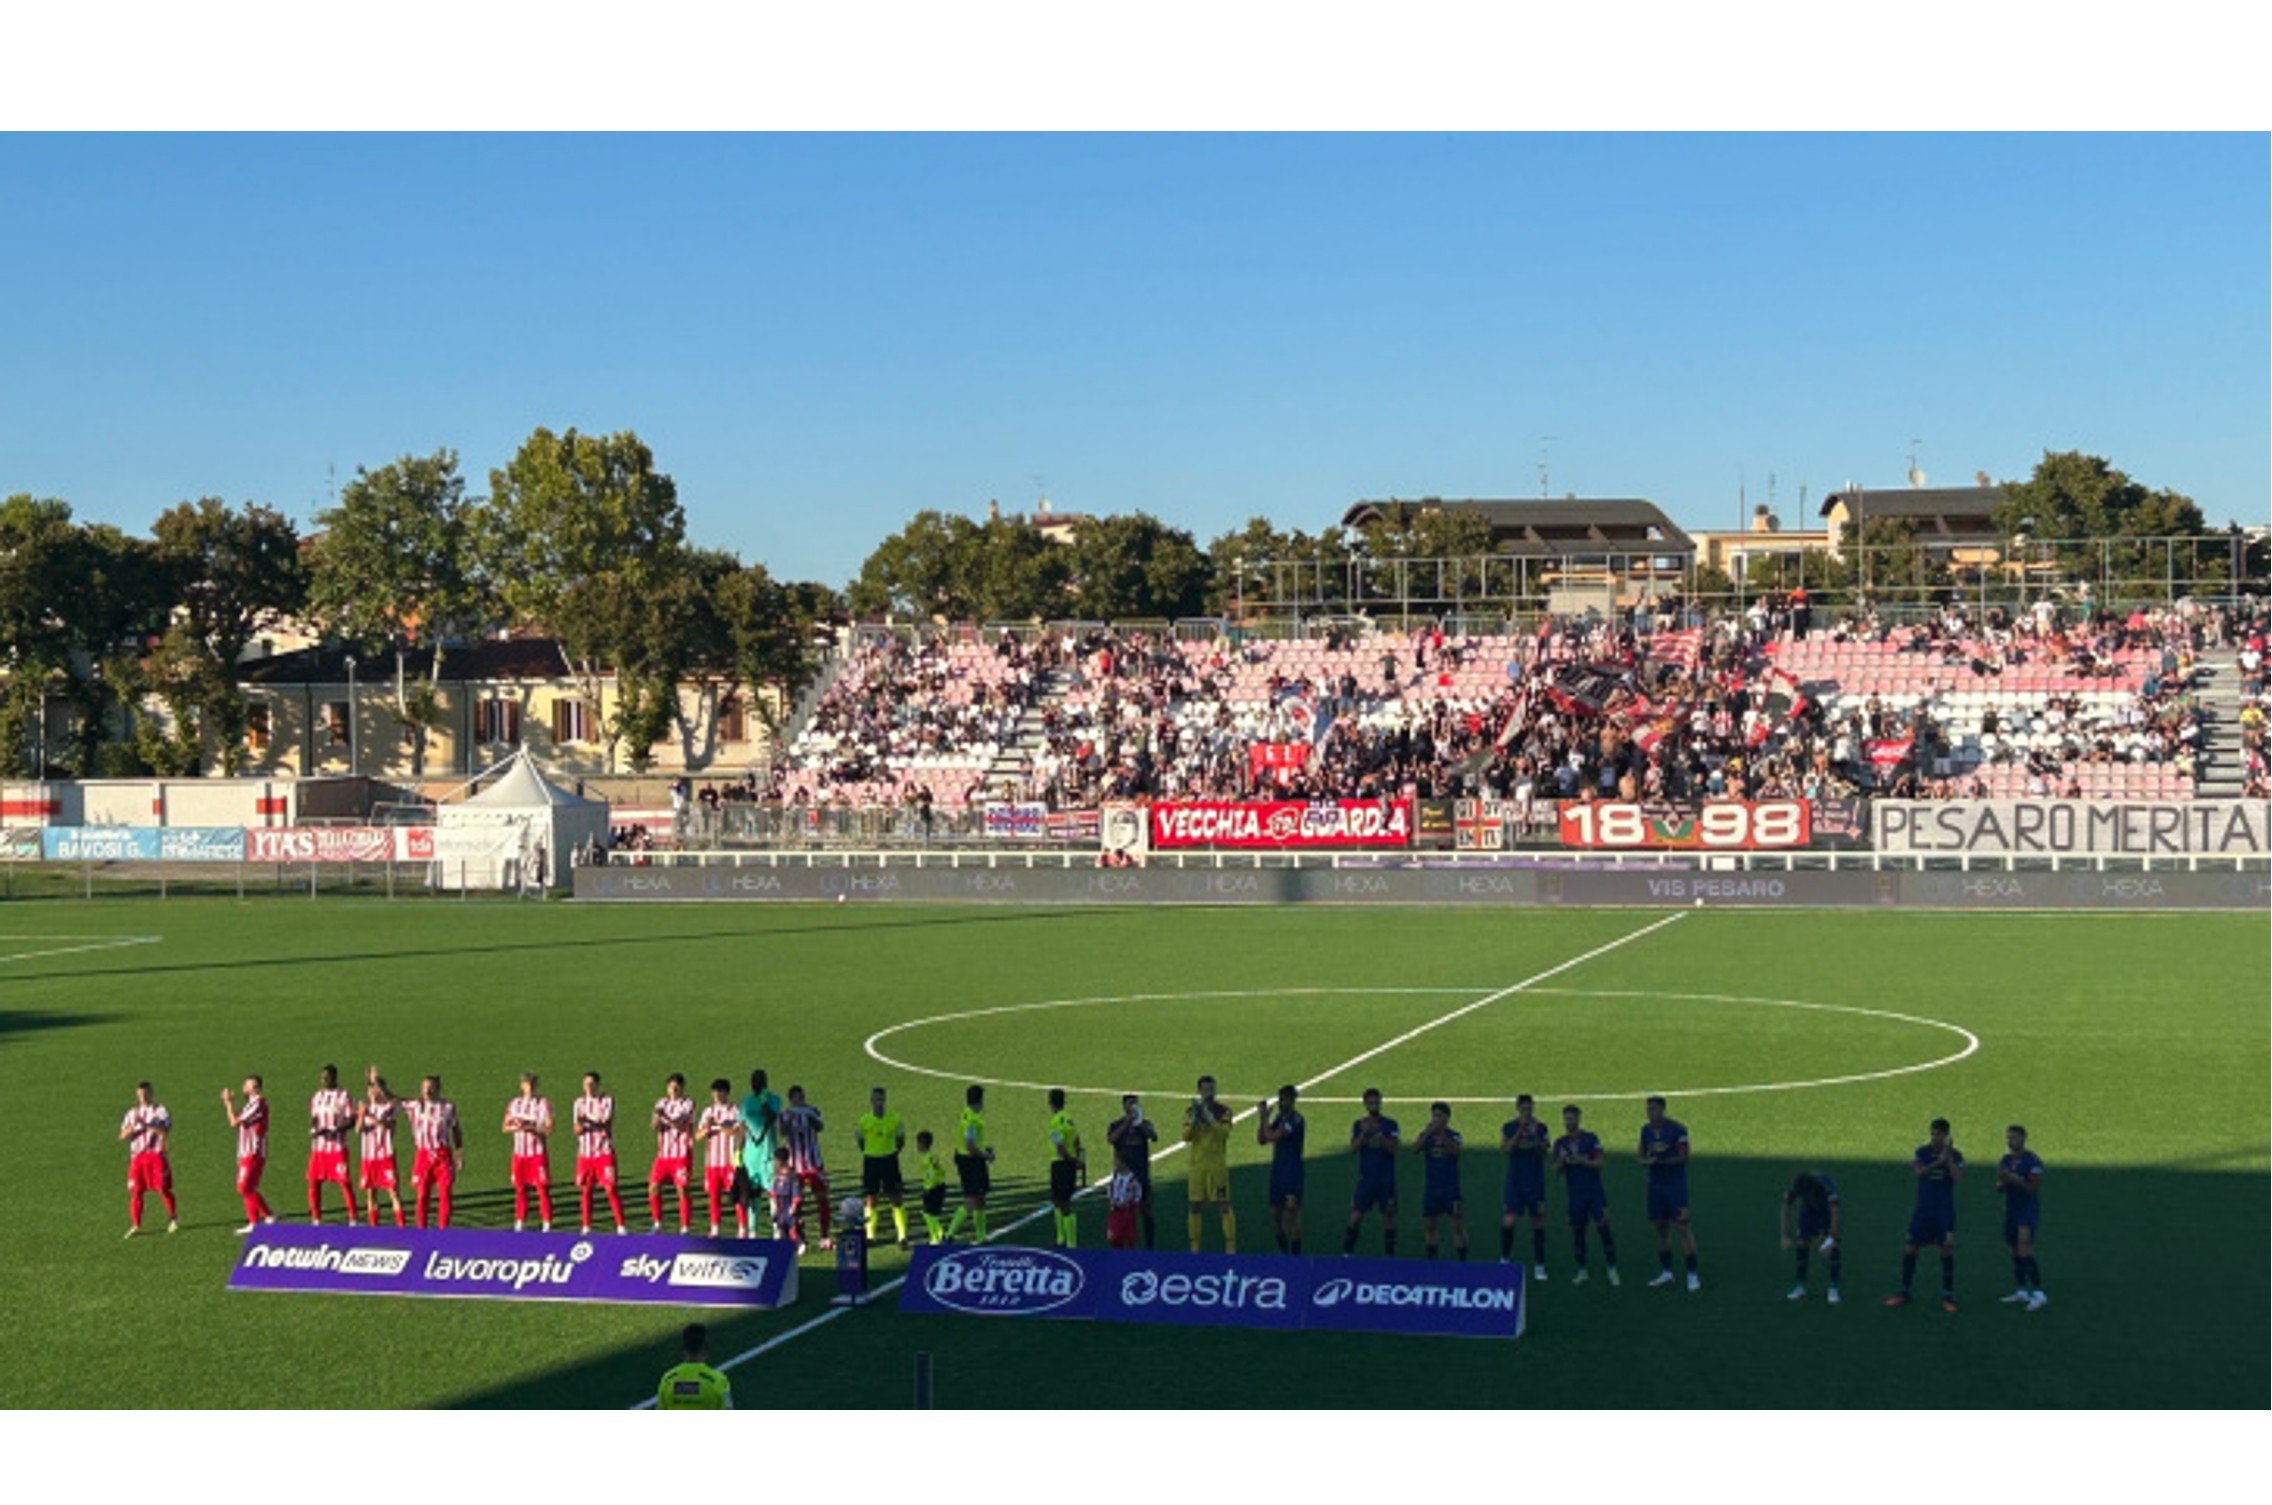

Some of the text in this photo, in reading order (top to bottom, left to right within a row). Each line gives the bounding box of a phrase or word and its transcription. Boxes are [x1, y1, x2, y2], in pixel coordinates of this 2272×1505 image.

[1158, 808, 1261, 838] VECCHIA
[1301, 807, 1406, 837] GUARDA
[1565, 803, 1645, 845] 18
[1701, 803, 1800, 845] 98
[1880, 803, 2075, 851] PESARO
[2087, 804, 2260, 853] MERITA
[732, 874, 780, 890] HEXA
[851, 874, 899, 890] HEXA
[1334, 876, 1389, 893] HEXA
[1460, 876, 1514, 893] HEXA
[1649, 879, 1785, 897] VIS PESARO
[1963, 878, 2025, 896] HEXA
[2102, 879, 2165, 897] HEXA
[346, 1252, 403, 1270] NEWS
[619, 1253, 725, 1283] sky wifi
[932, 1259, 1074, 1295] Beretta
[1160, 1268, 1287, 1308] estra
[1355, 1283, 1515, 1310] DECATHLON
